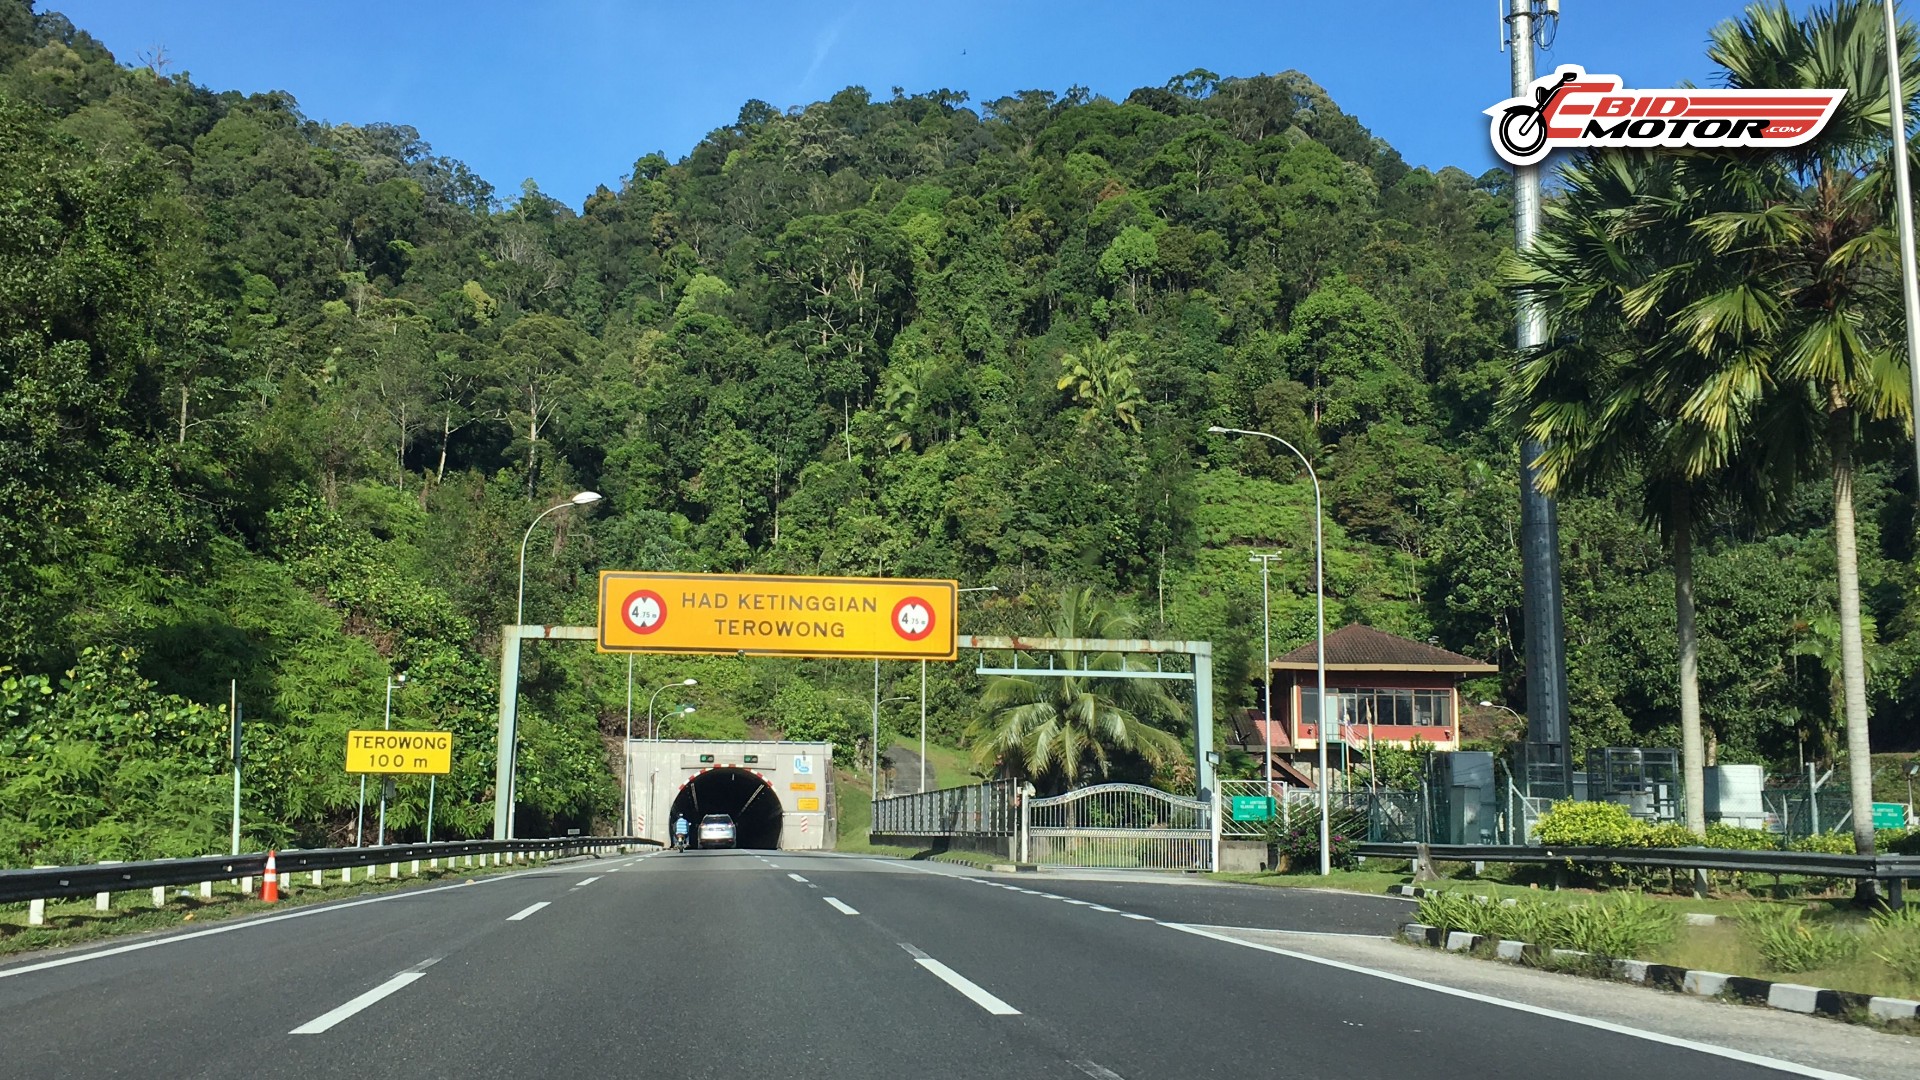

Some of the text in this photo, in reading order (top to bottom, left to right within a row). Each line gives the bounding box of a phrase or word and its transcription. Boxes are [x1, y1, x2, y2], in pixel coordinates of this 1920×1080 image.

[682, 592, 877, 613] HAD KETINGGIAN
[714, 619, 845, 638] TEROWONG
[353, 735, 447, 750] TEROWONG
[370, 754, 428, 768] 100 m
